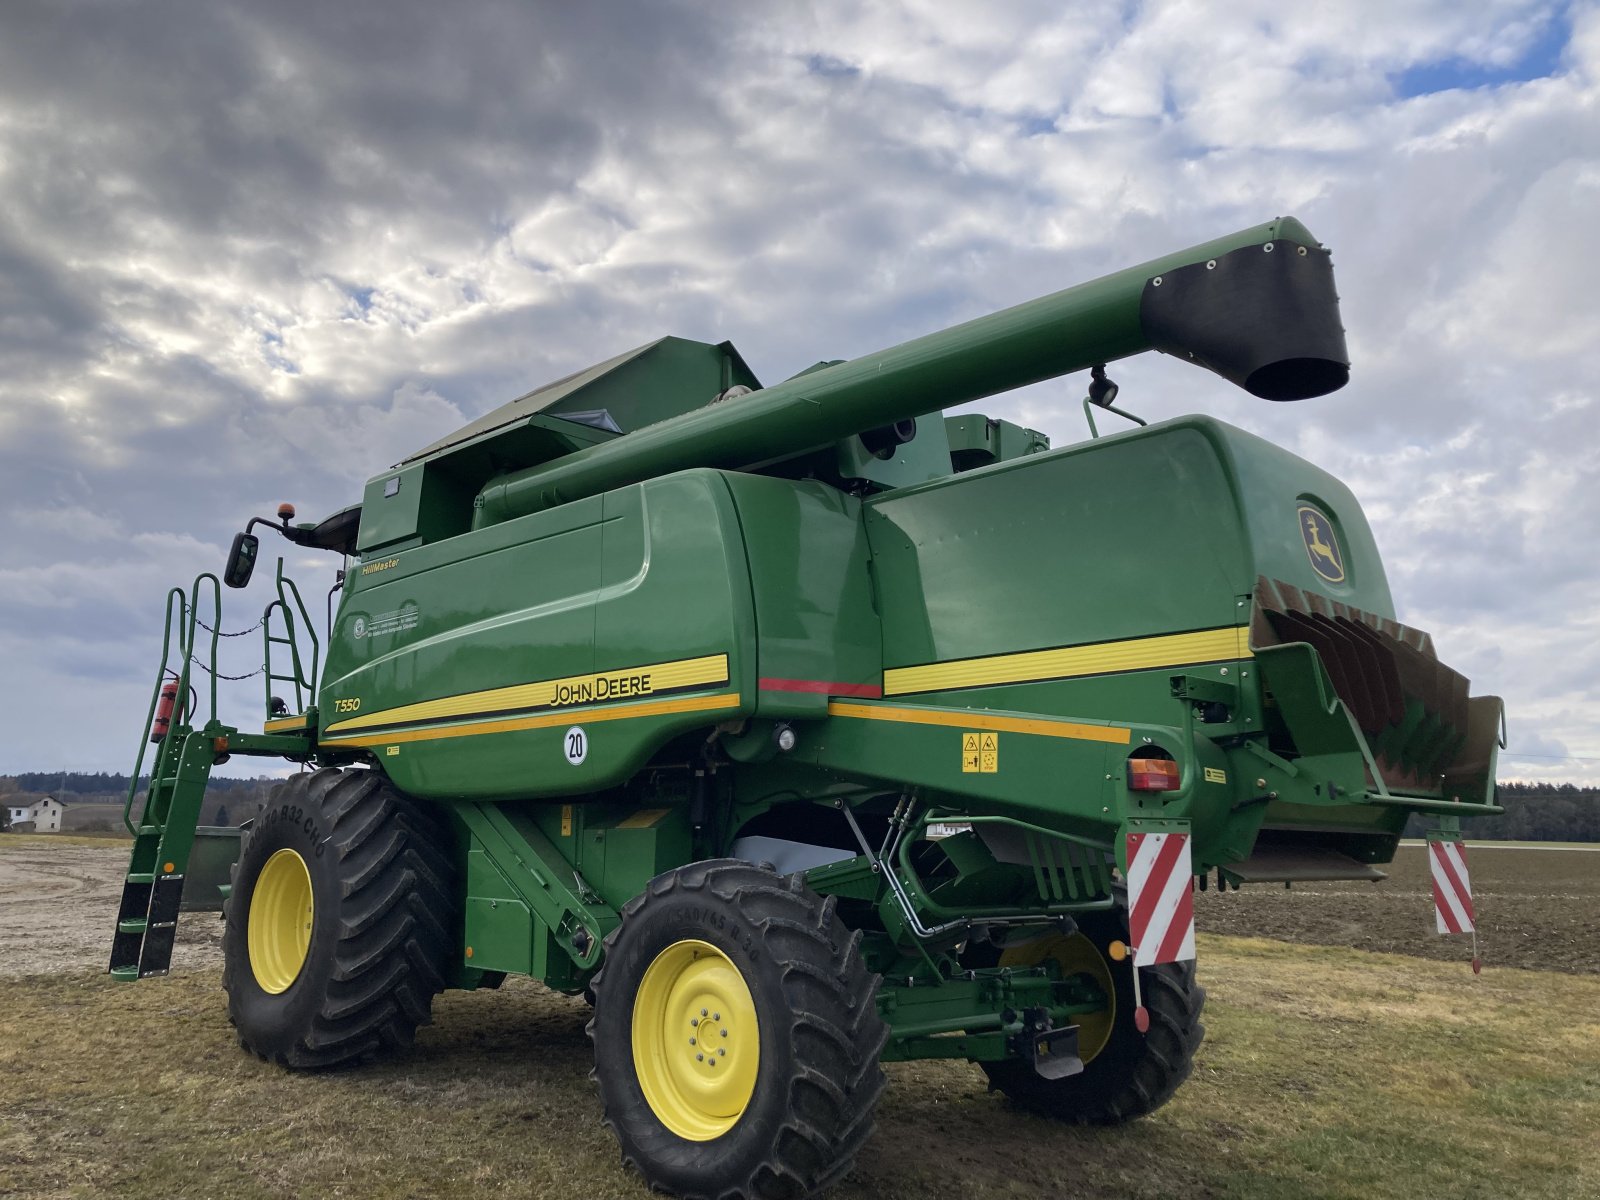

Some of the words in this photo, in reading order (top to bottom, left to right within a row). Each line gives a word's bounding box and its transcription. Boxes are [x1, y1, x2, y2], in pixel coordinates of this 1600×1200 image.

[362, 559, 400, 575] HillMaster
[551, 683, 592, 704] JOHN
[597, 675, 651, 697] DEERE
[335, 698, 360, 712] T550
[569, 733, 583, 758] 20
